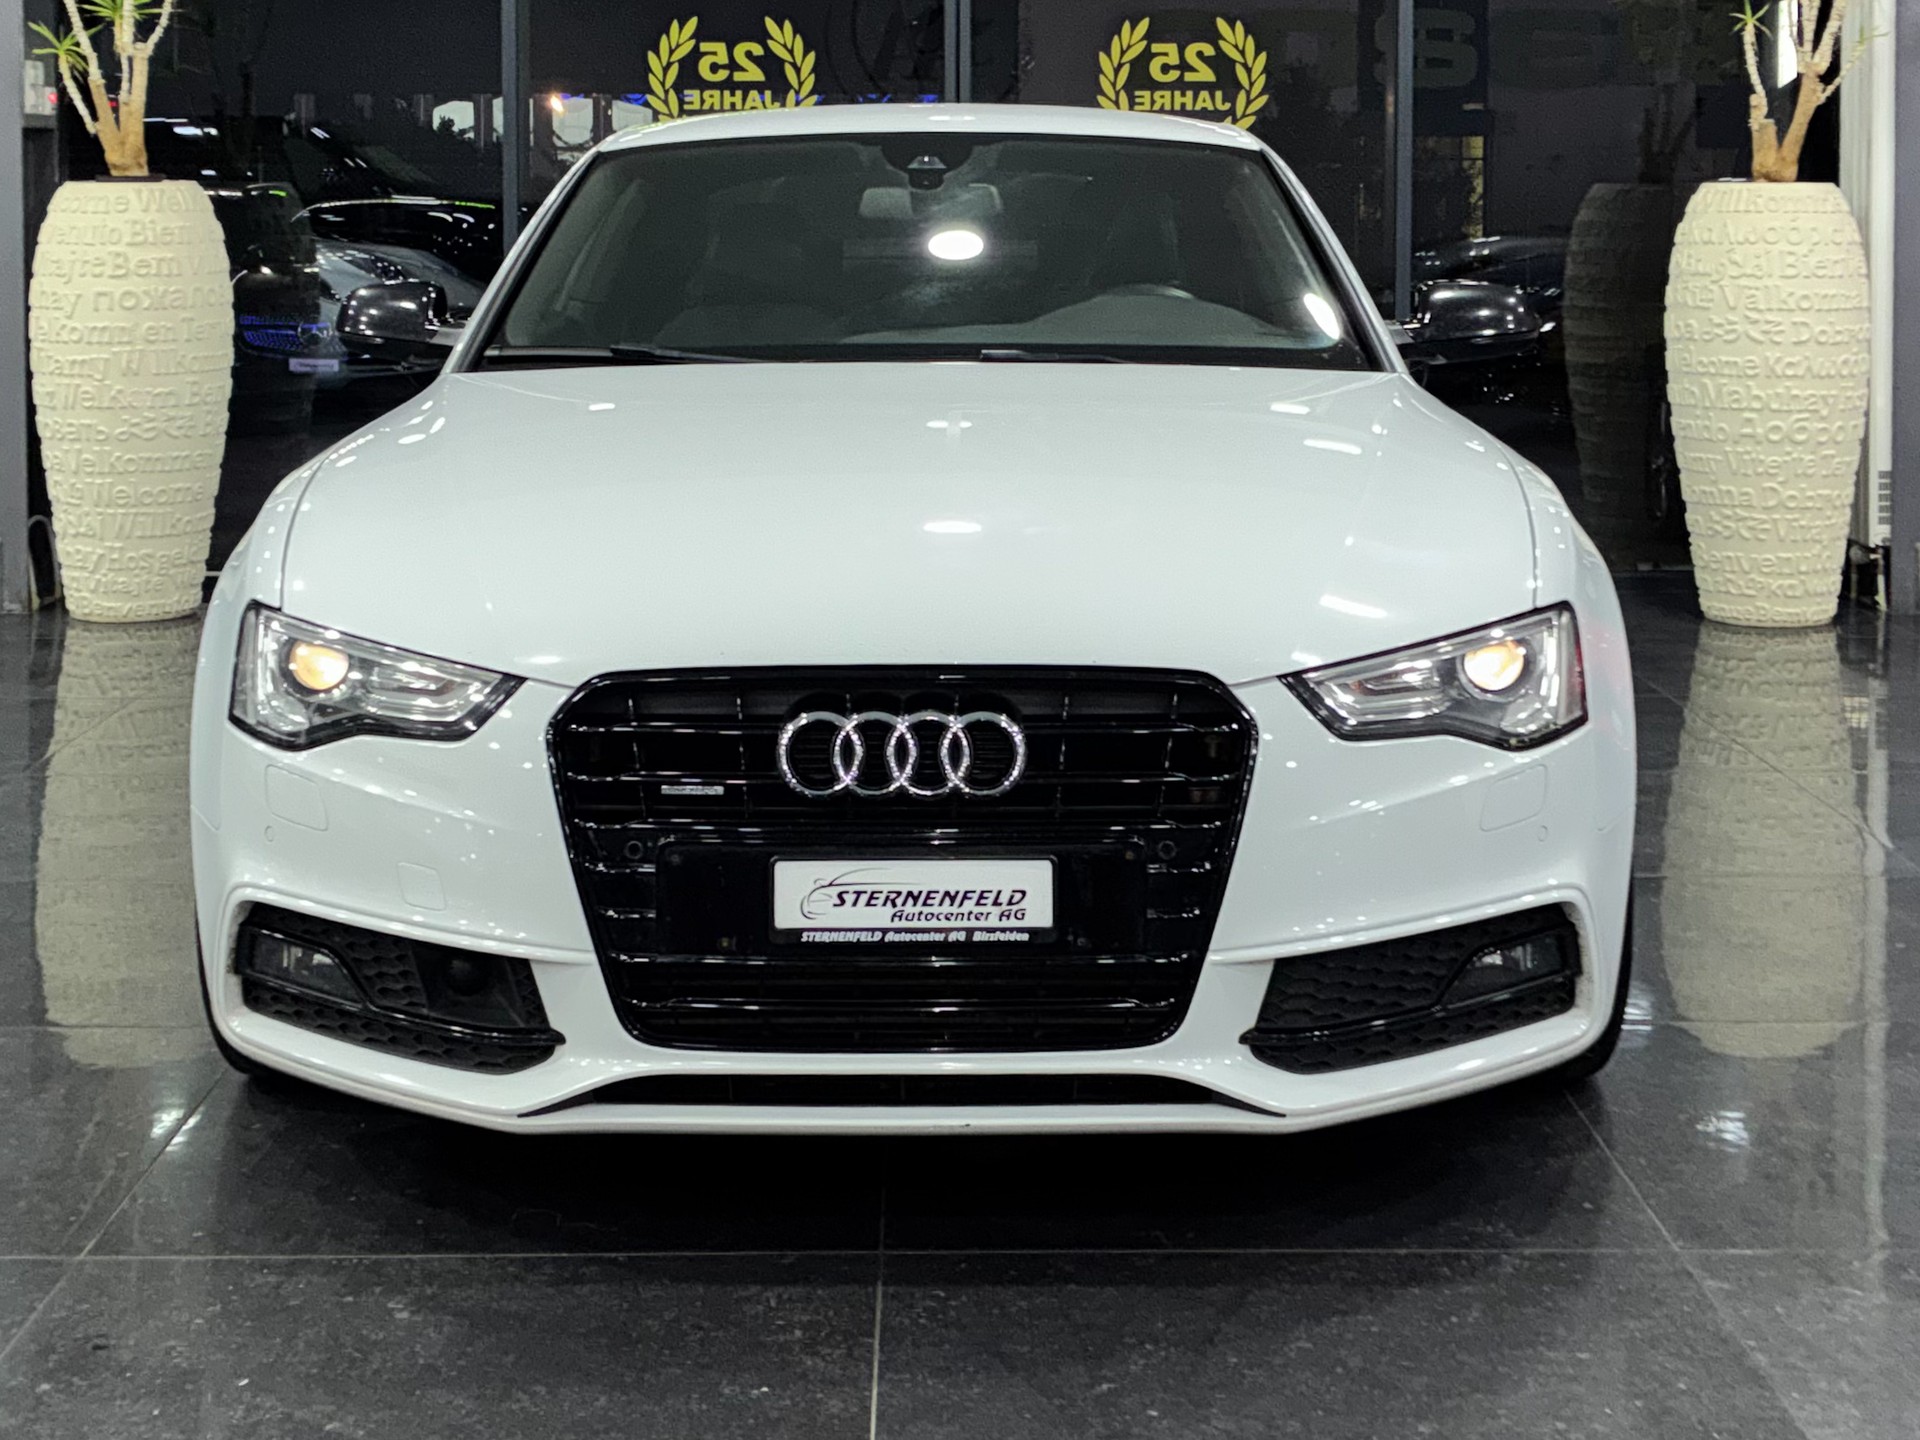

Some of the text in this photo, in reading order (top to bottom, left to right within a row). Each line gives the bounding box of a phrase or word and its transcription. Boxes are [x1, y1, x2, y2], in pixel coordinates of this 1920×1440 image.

[832, 889, 1027, 909] STERNENFELD
[891, 908, 1026, 923] Autocenter AG
[800, 931, 882, 942] STERNENFELD
